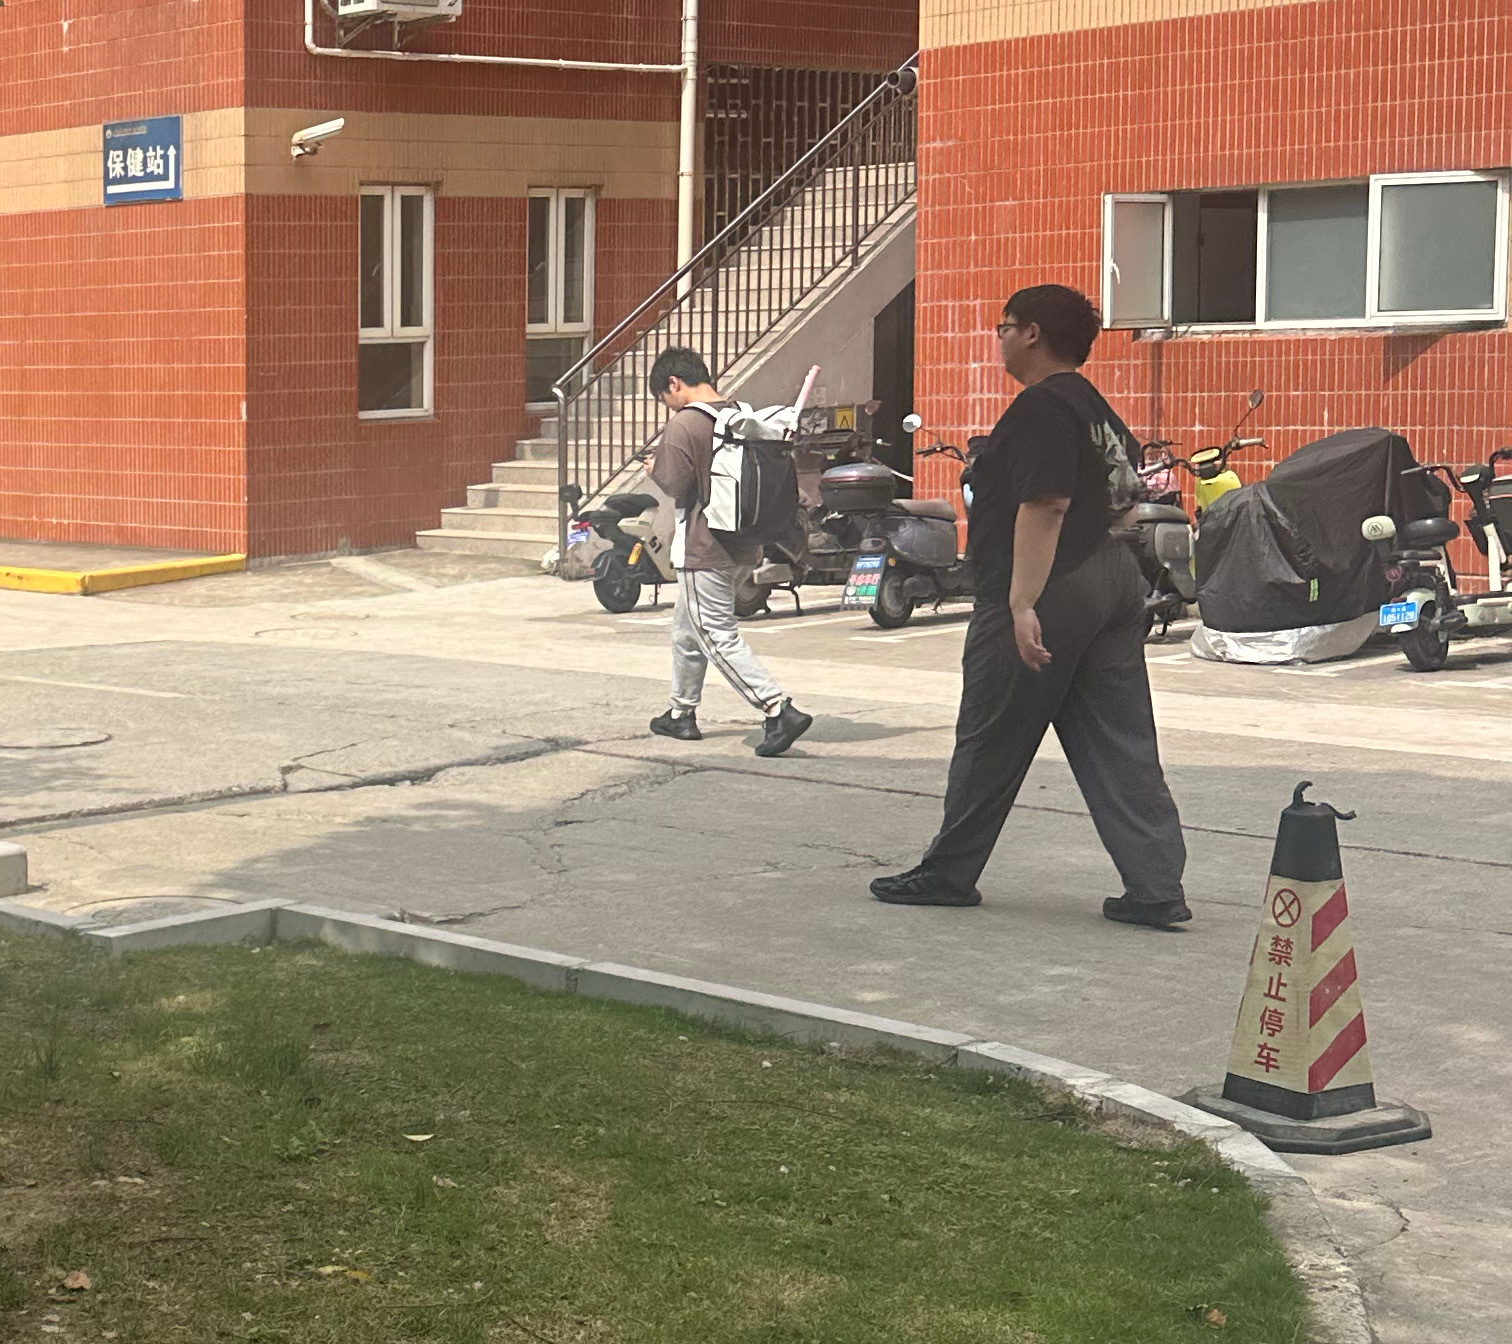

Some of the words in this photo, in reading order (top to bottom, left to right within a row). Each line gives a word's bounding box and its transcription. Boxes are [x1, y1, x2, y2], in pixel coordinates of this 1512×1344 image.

[106, 144, 165, 179] 保健站
[1253, 934, 1294, 1073] 禁止停车
